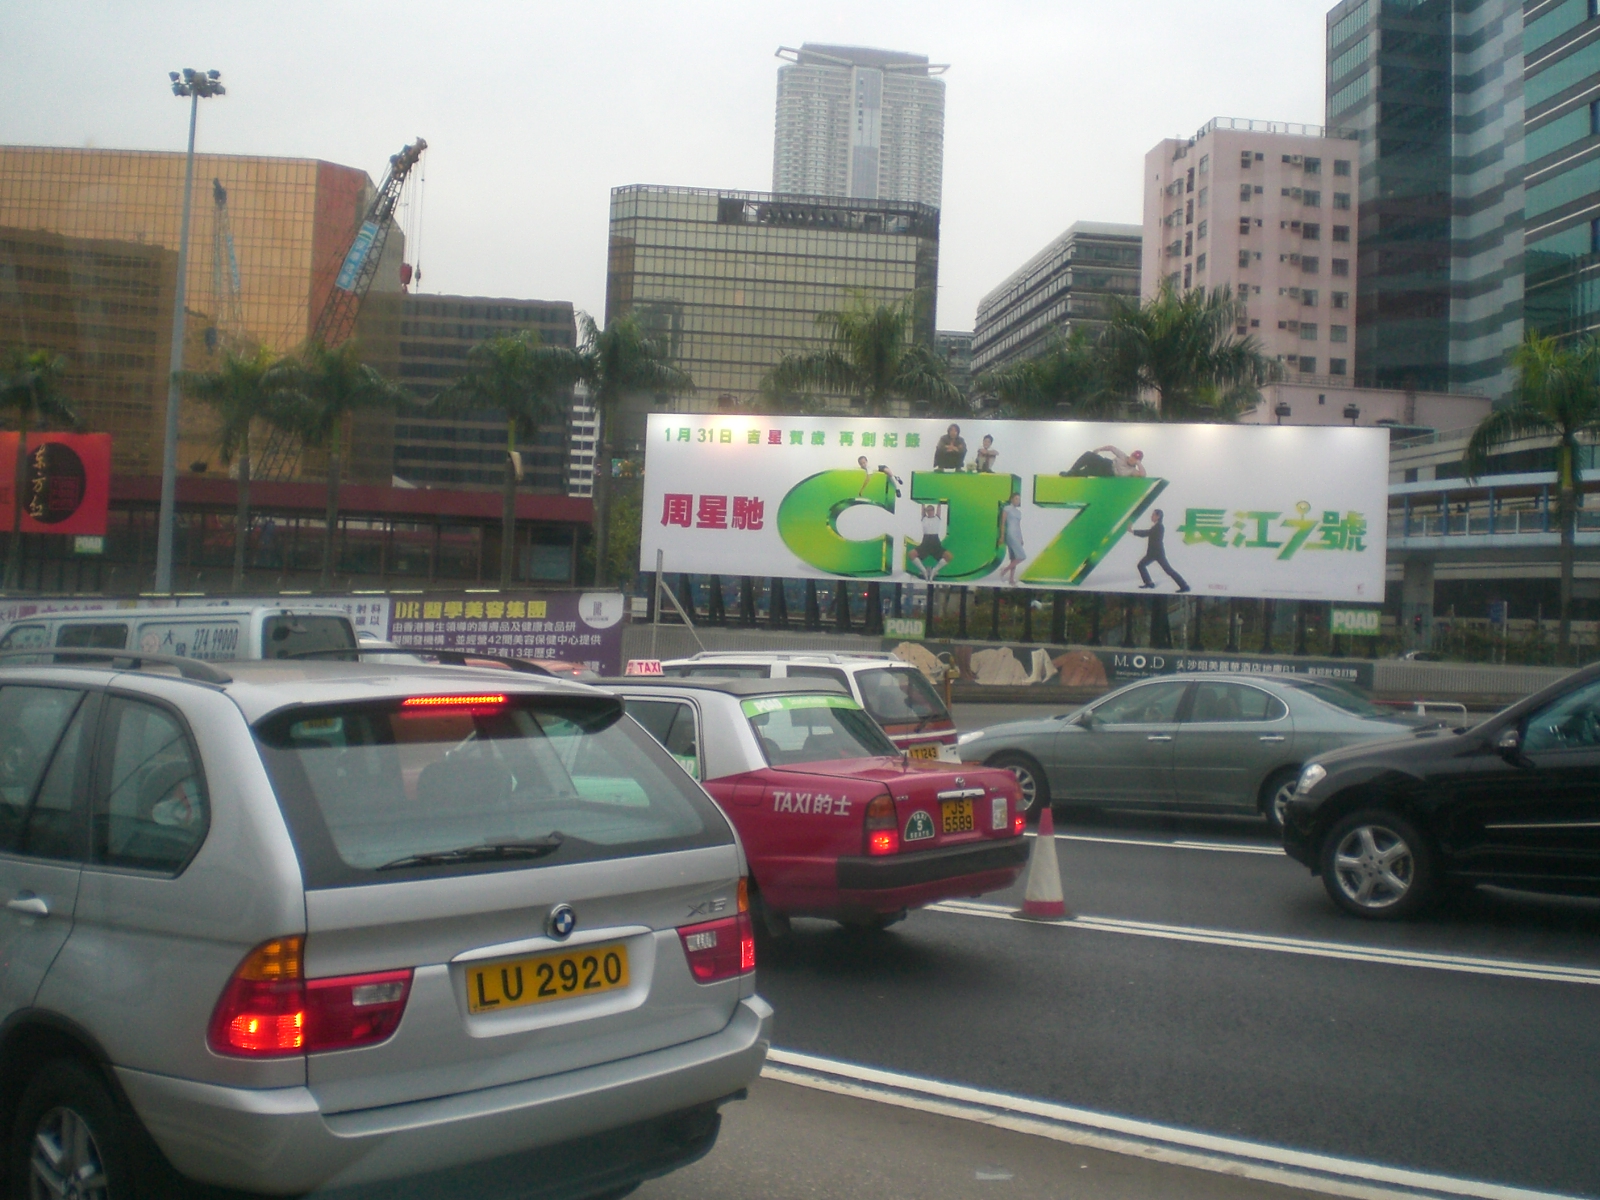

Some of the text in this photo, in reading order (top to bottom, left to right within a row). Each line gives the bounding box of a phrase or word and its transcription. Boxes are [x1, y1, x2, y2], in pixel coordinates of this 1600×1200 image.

[660, 492, 765, 531] 周星馳
[776, 469, 1170, 586] CJ7
[1175, 501, 1368, 561] 長江7號
[887, 619, 923, 634] POAD
[1333, 611, 1379, 630] POAD
[637, 661, 661, 673] TAXI
[772, 791, 852, 816] TAXI 的士
[917, 820, 923, 831] 5
[945, 815, 972, 831] 5589
[476, 952, 622, 1007] LU 2920
